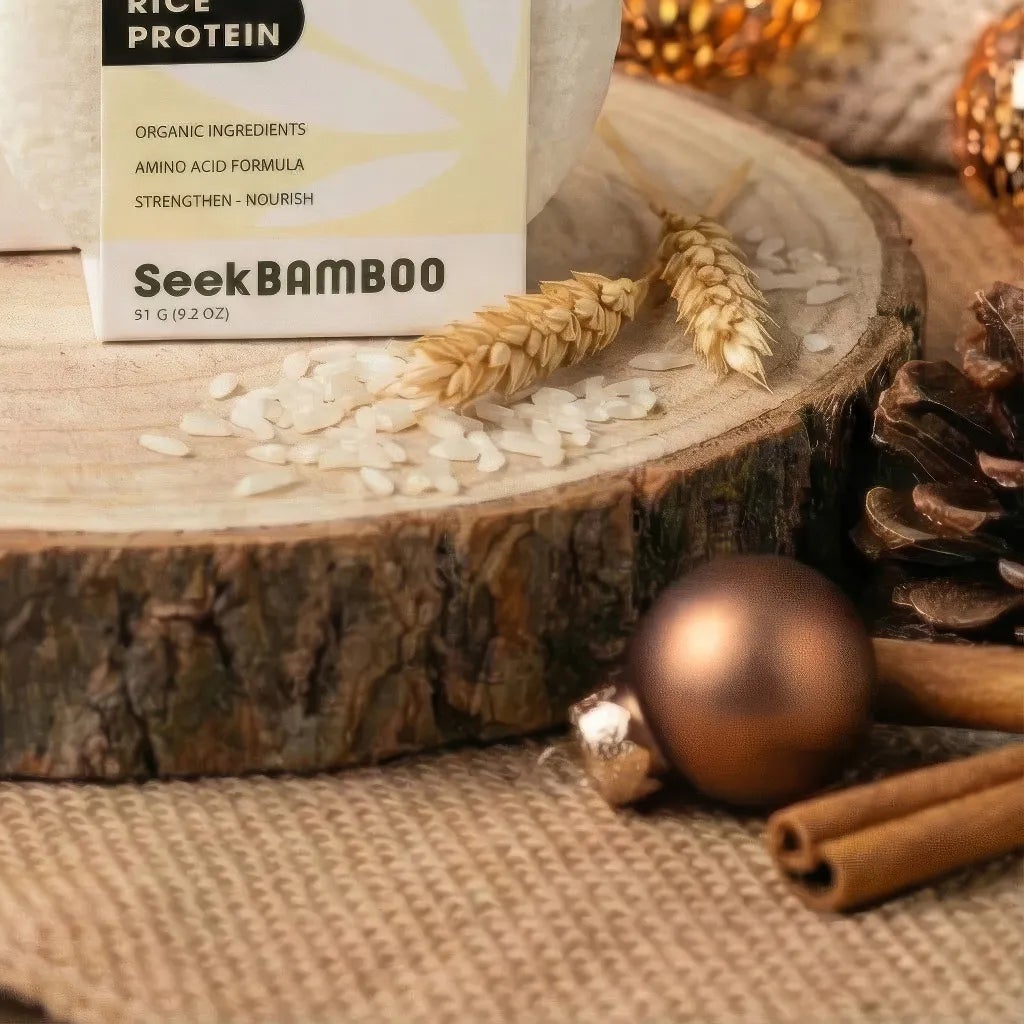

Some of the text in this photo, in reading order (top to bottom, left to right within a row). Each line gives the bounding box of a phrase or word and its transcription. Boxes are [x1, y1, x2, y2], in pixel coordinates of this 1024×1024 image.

[128, 22, 280, 49] PROTEIN
[135, 122, 306, 139] ORGANIC INGREDIENTS
[135, 158, 305, 174] AMINO ACID FORMULA
[134, 194, 232, 208] STRENGTHEN
[246, 192, 314, 207] NOURISH
[134, 257, 445, 298] SeekBAMBOO
[157, 308, 168, 321] G
[172, 307, 199, 323] (9.2
[203, 306, 230, 322] OZ)
